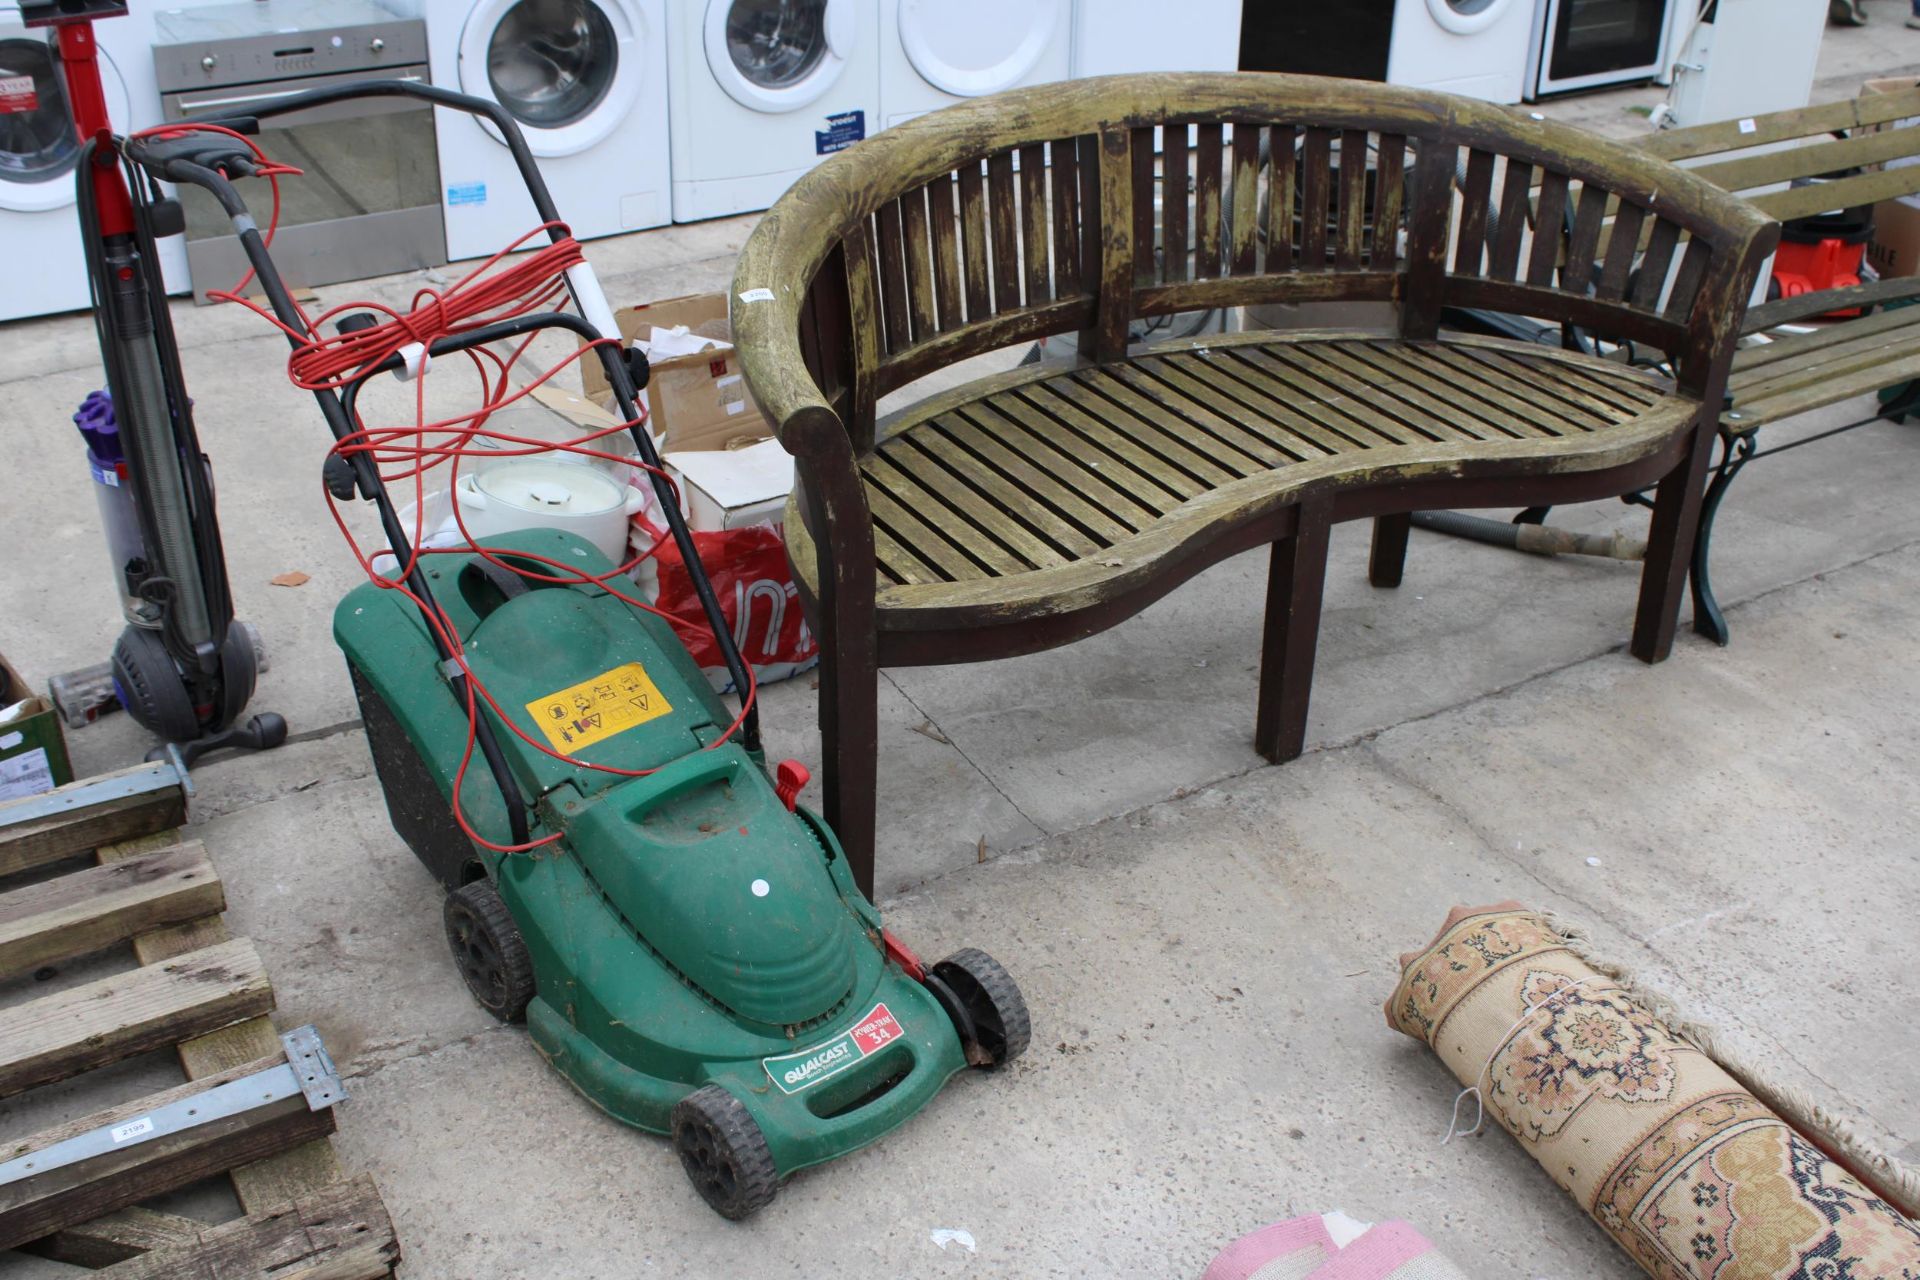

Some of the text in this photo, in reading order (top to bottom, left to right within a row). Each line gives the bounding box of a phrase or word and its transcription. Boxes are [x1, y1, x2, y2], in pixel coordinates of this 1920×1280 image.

[868, 1028, 891, 1044] 34
[784, 1041, 849, 1084] QUALCAST
[120, 1123, 145, 1136] 2199
